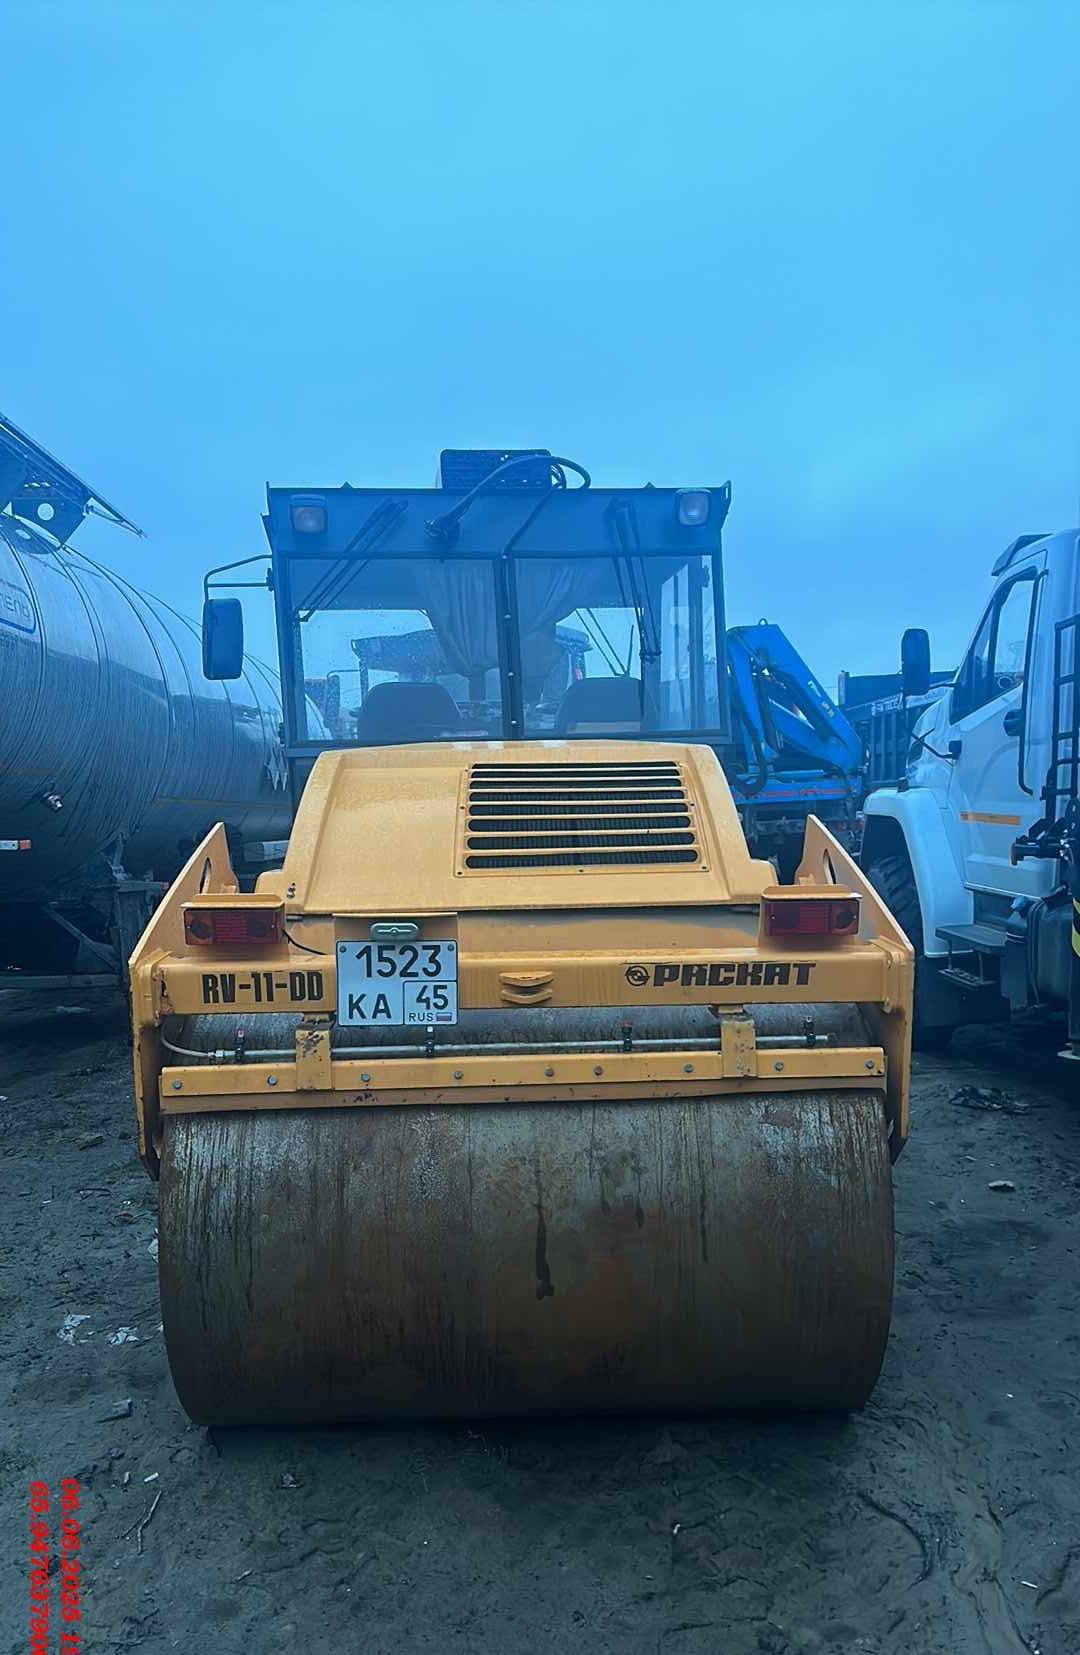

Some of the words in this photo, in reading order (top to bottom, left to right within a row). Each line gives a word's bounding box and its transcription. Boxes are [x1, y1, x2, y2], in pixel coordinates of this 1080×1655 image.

[355, 944, 442, 978] 1523
[202, 971, 324, 1004] RV-11-DD
[415, 985, 449, 1010] 45
[408, 1012, 434, 1022] RUS
